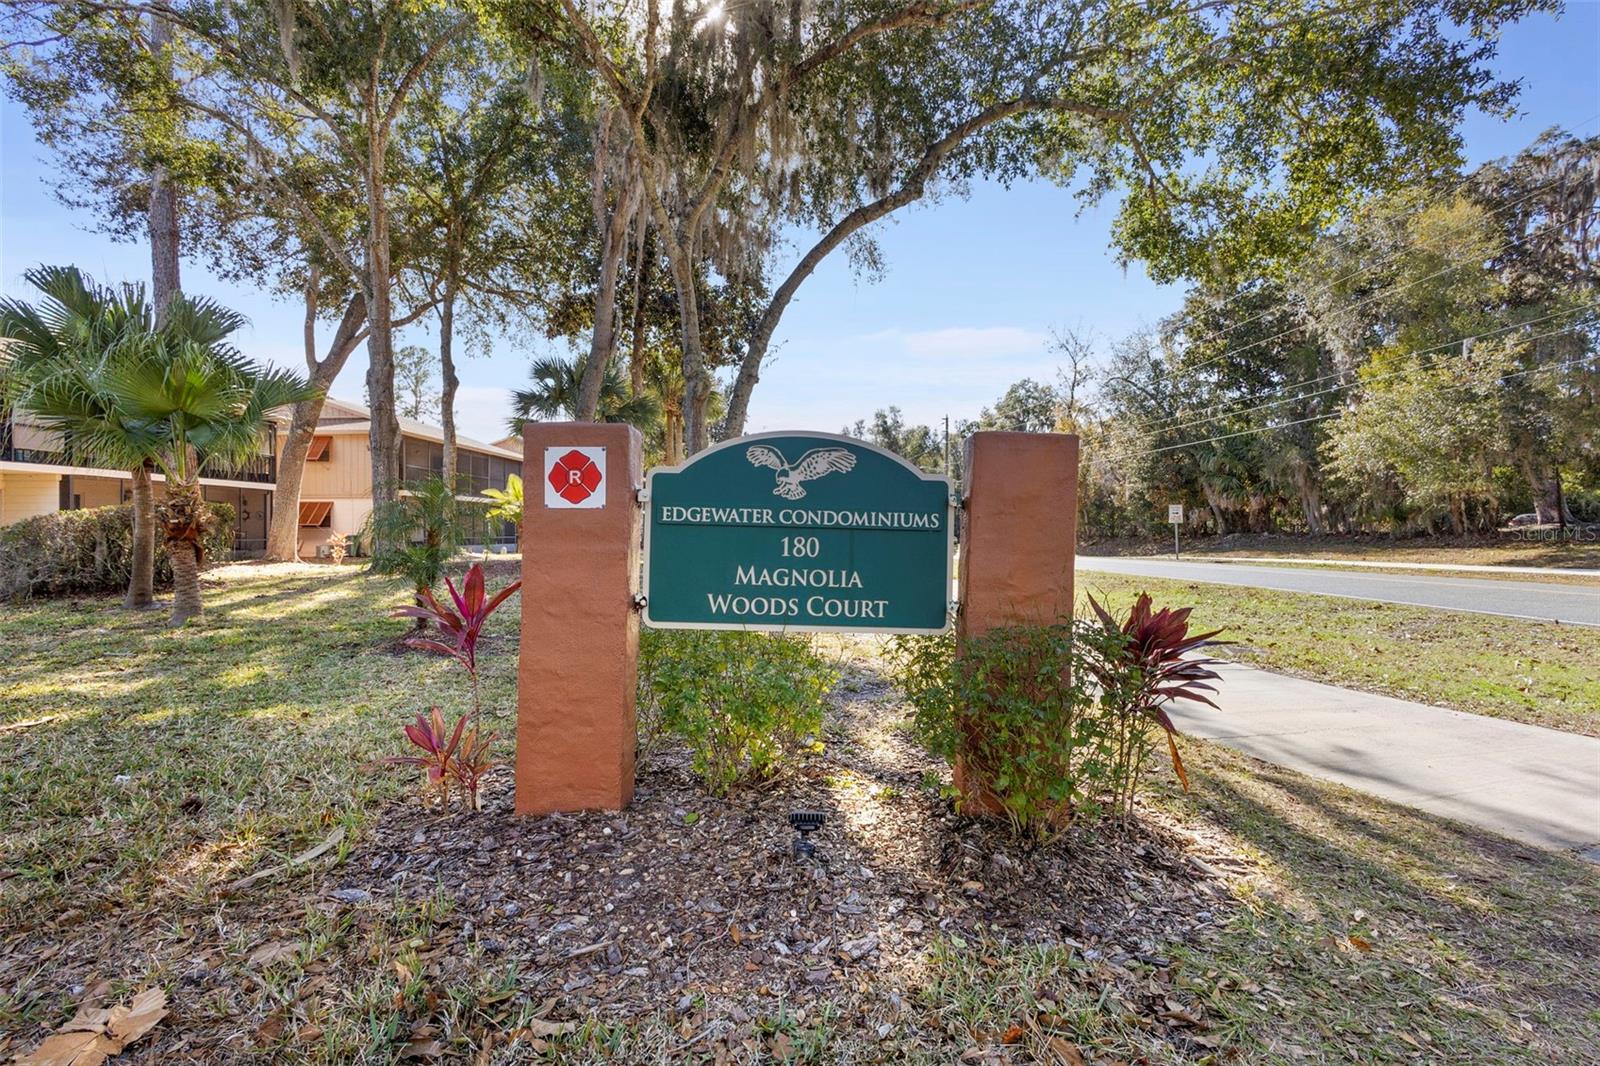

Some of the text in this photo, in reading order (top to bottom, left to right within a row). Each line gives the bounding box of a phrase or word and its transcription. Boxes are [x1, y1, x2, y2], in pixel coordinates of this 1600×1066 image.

[569, 469, 582, 484] R
[661, 506, 940, 529] EDGEWATER CONDOMINIUMS
[780, 536, 820, 558] 180
[734, 565, 863, 588] MAGNOLIA
[707, 593, 889, 619] WOODS COURT
